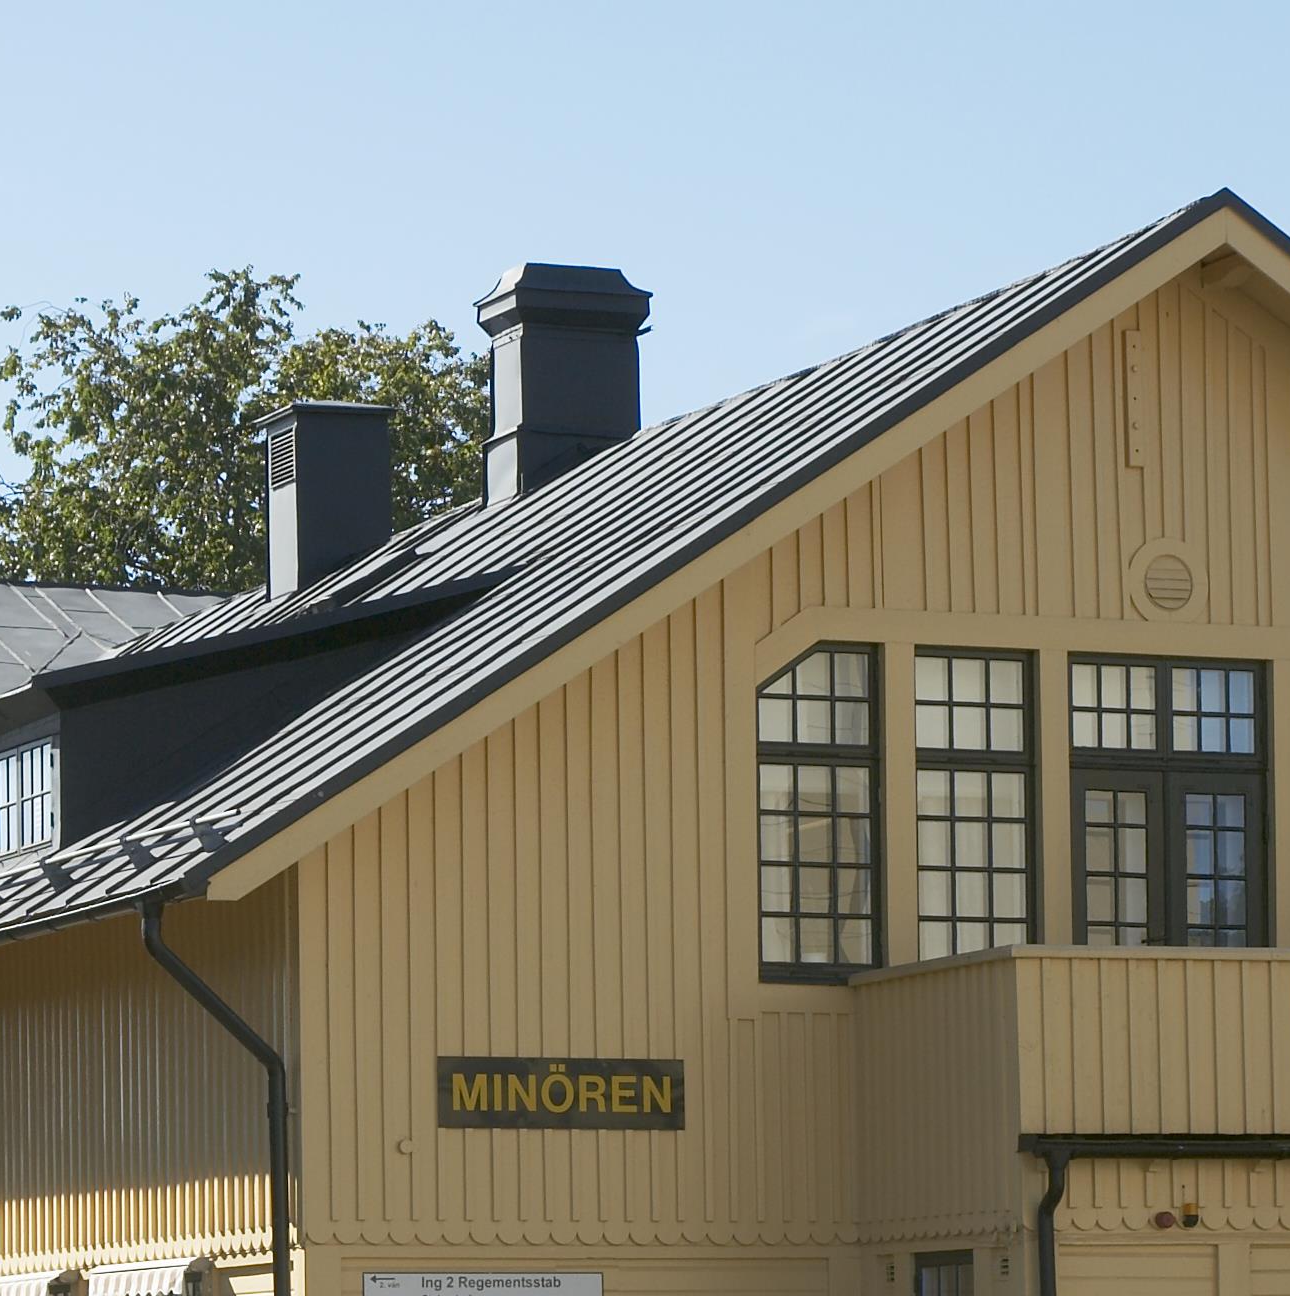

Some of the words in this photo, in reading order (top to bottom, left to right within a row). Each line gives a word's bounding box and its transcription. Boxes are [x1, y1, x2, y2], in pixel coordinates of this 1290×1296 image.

[452, 1063, 672, 1113] MINÖREN
[421, 1276, 442, 1291] Ing
[446, 1276, 454, 1288] 2
[458, 1275, 561, 1291] Regementsstab
